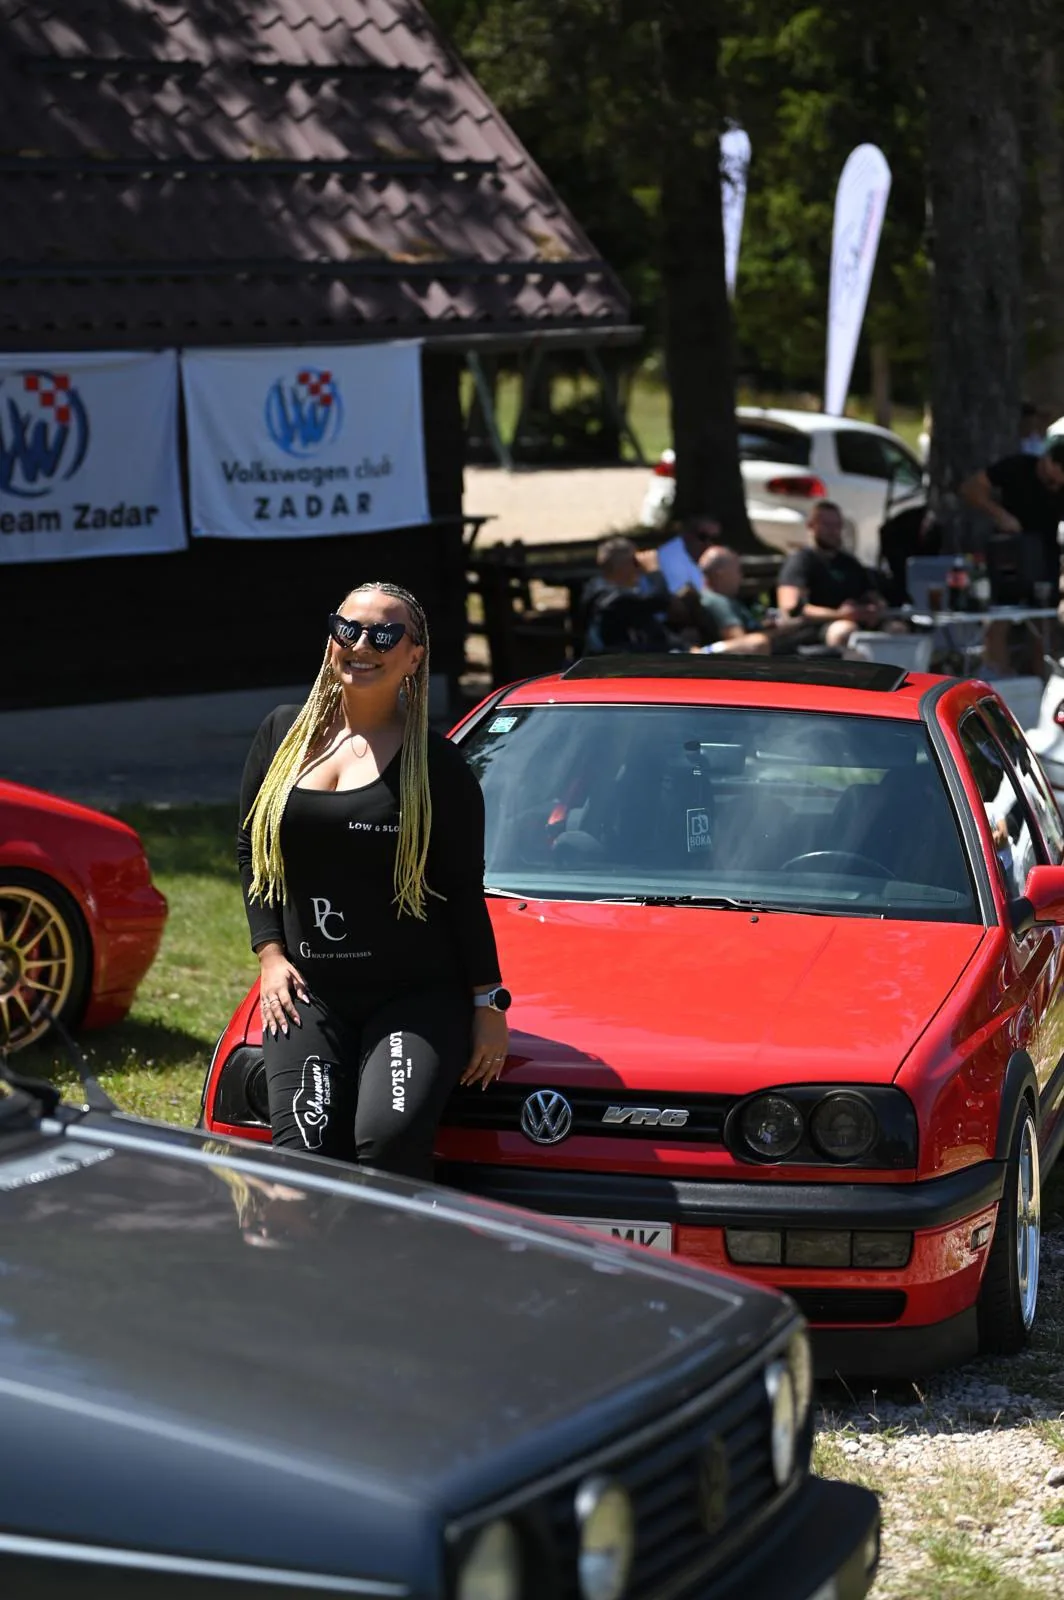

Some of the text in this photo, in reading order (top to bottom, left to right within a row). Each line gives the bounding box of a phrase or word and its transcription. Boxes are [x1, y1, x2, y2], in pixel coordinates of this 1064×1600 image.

[221, 455, 392, 487] Volkswagen club
[0, 502, 159, 534] eam Zadar
[254, 491, 371, 520] ZADAR
[337, 624, 393, 645] TOO SEXY
[348, 821, 372, 831] LOW
[382, 825, 402, 833] SLO
[390, 1031, 403, 1058] LOW
[304, 1063, 328, 1127] Schuman
[323, 1063, 331, 1105] Detailing
[391, 1069, 405, 1113] SLOW
[602, 1106, 689, 1127] VR6
